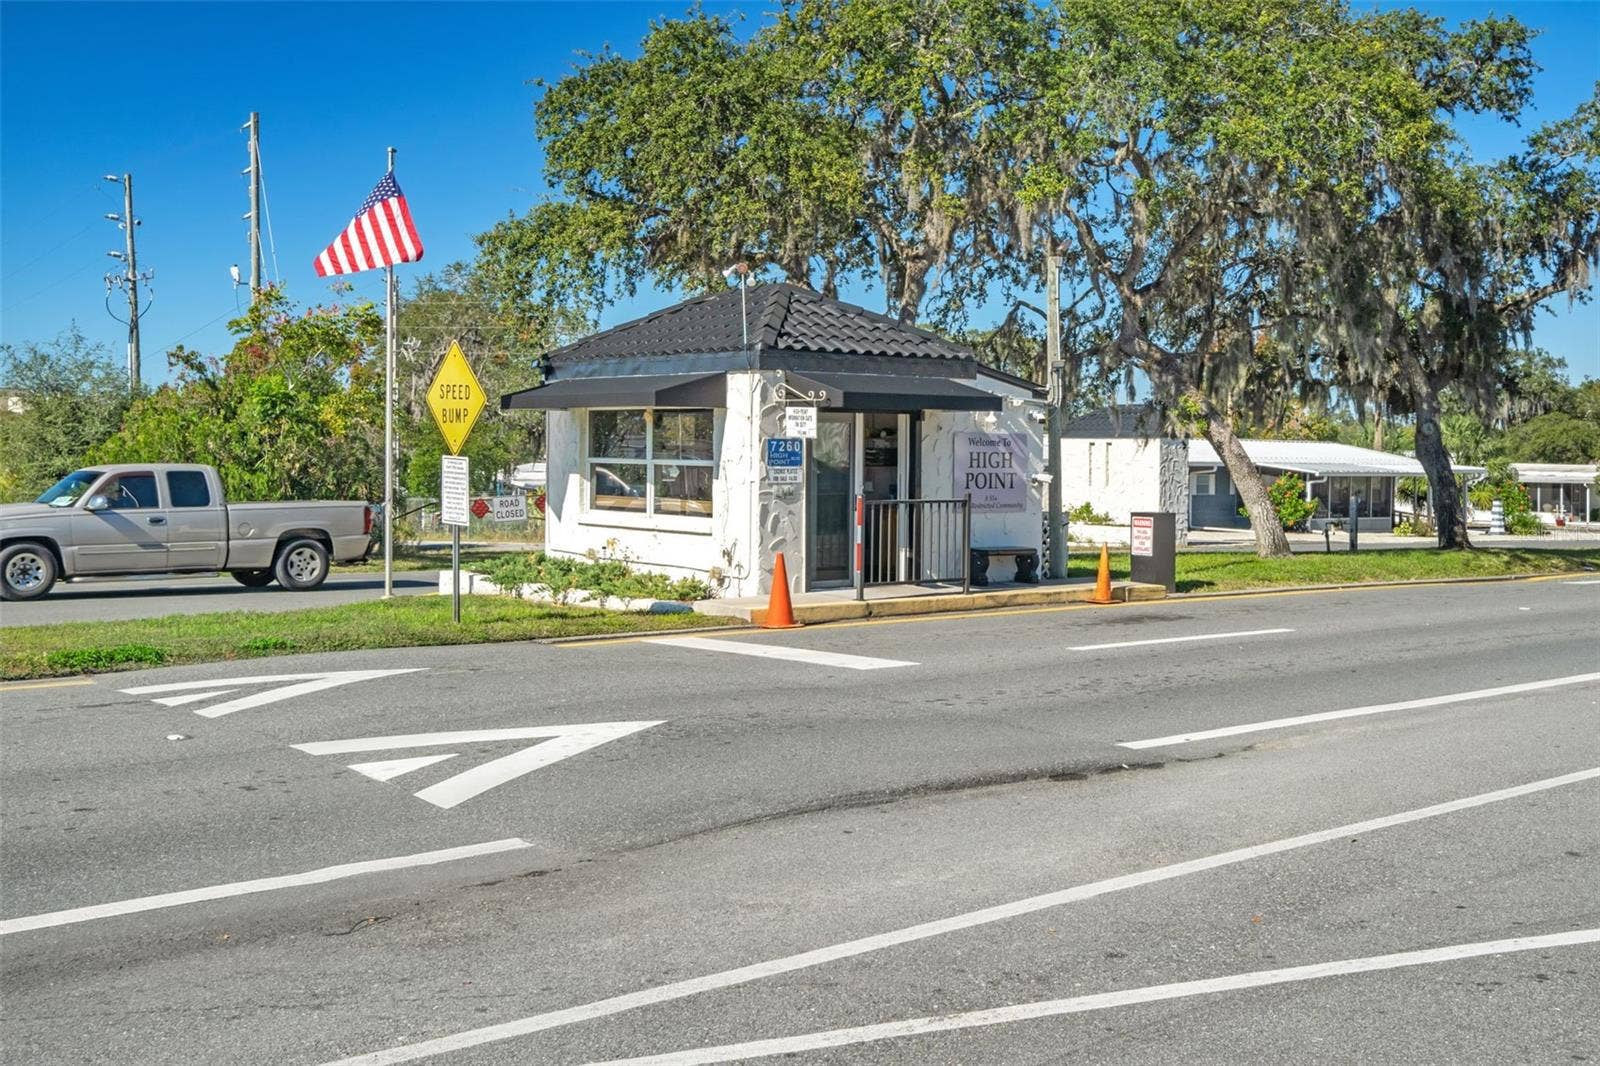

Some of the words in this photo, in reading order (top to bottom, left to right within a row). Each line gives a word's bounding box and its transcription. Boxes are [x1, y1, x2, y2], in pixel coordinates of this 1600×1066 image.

[440, 384, 471, 400] SPEED
[442, 408, 469, 423] BUMP
[770, 441, 801, 451] 7260
[968, 437, 1001, 447] Welcome
[1002, 437, 1012, 447] To
[770, 451, 789, 459] HIGH
[968, 451, 1014, 469] HIGH
[965, 472, 1017, 490] POINT
[499, 499, 520, 509] ROAD
[496, 509, 525, 519] CLOSED
